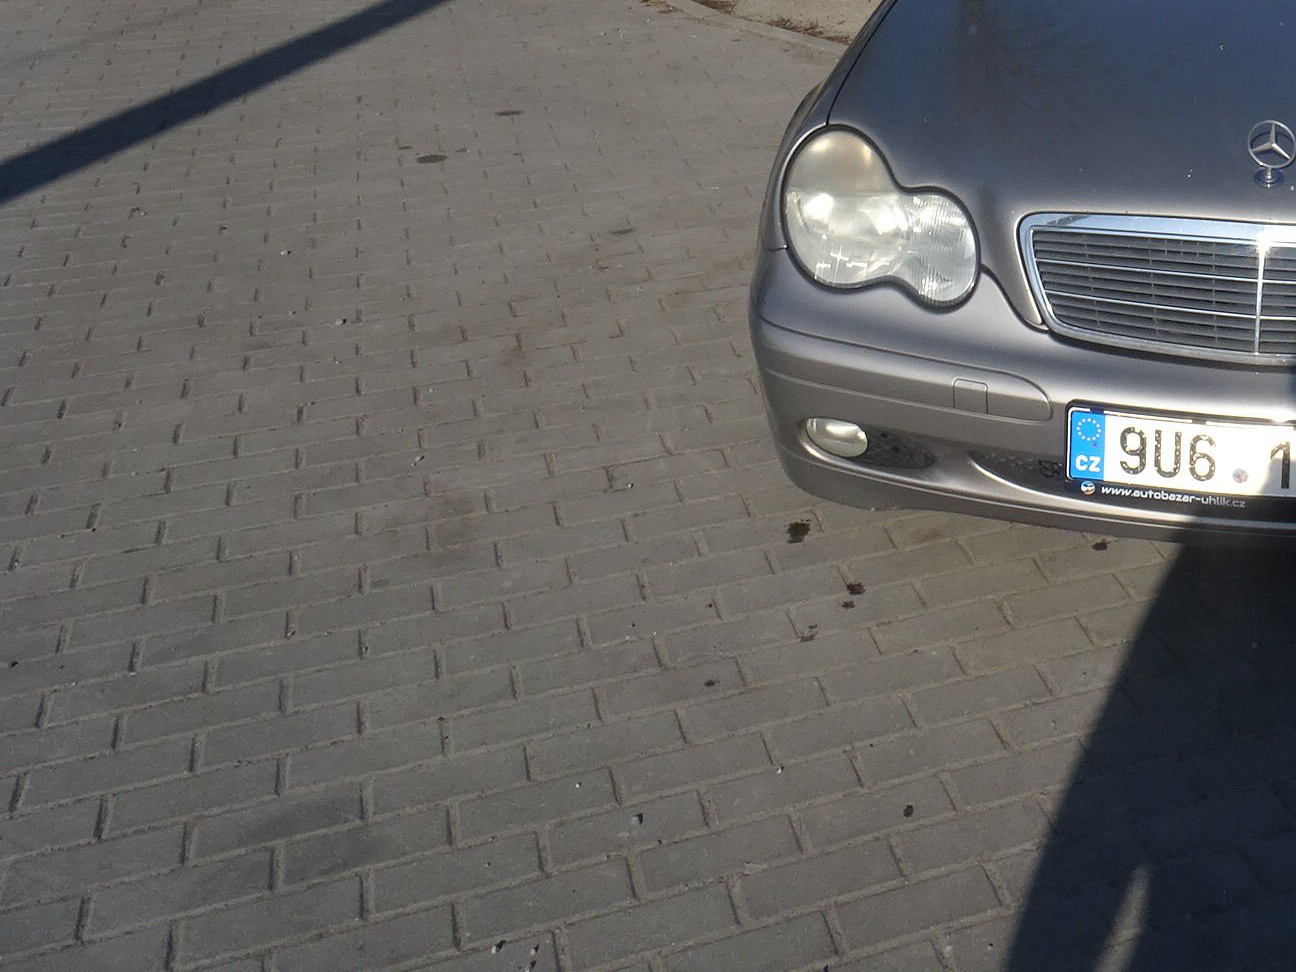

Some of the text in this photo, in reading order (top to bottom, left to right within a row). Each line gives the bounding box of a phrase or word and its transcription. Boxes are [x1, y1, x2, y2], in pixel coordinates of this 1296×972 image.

[1075, 454, 1101, 473] CZ
[1119, 426, 1217, 482] 9U6
[1101, 485, 1246, 508] www.autobazar-uhlik.cz
